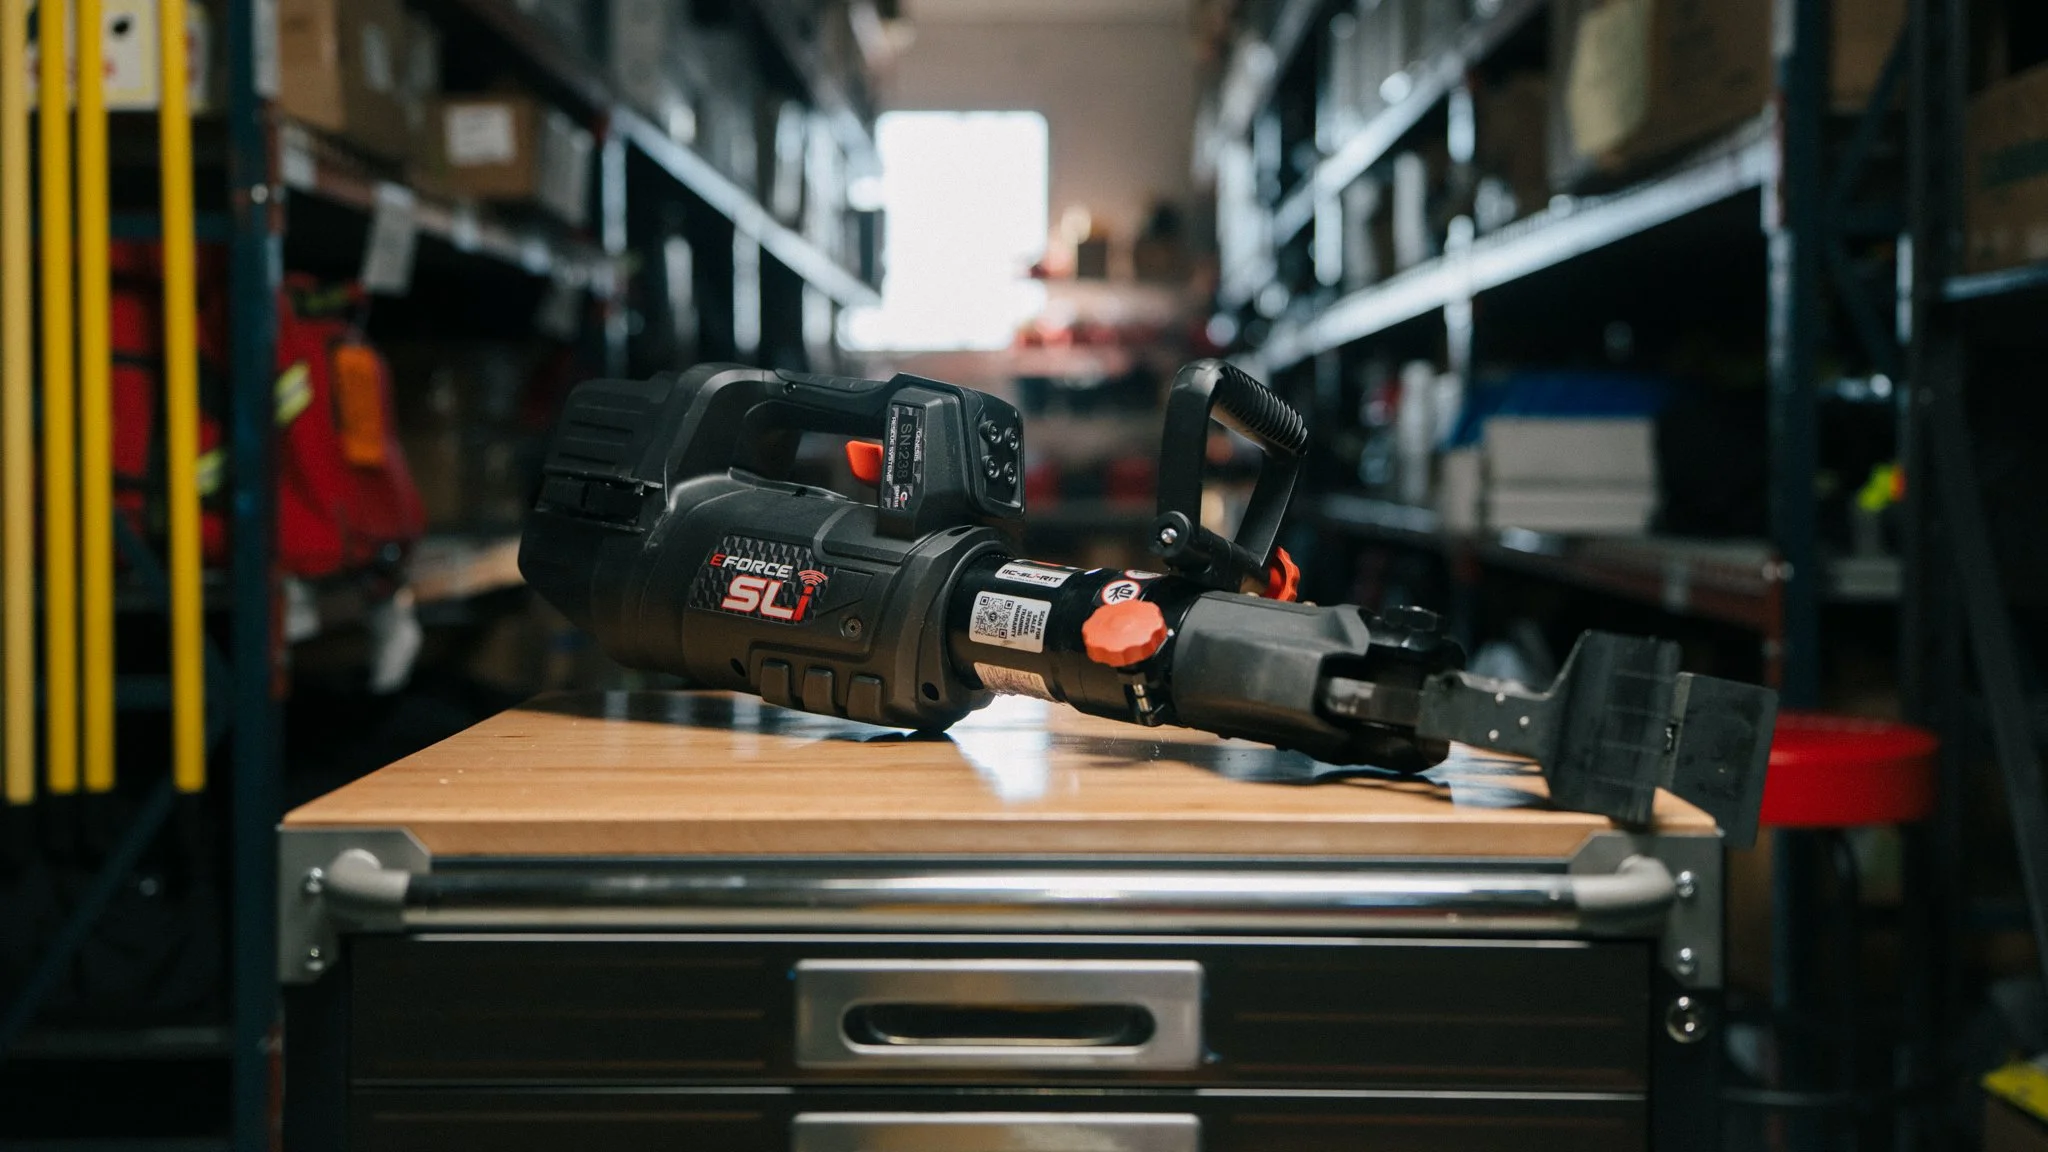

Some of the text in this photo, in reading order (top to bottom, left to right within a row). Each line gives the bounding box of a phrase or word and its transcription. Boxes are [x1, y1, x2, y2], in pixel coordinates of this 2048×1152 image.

[897, 423, 912, 479] SN:238
[709, 553, 794, 578] EFORCE
[1011, 605, 1022, 638] WARRANTY
[1017, 608, 1027, 636] TRAINING
[1023, 610, 1033, 635] SERVICE
[1029, 614, 1038, 633] SALES
[1037, 610, 1046, 626] SCAN
